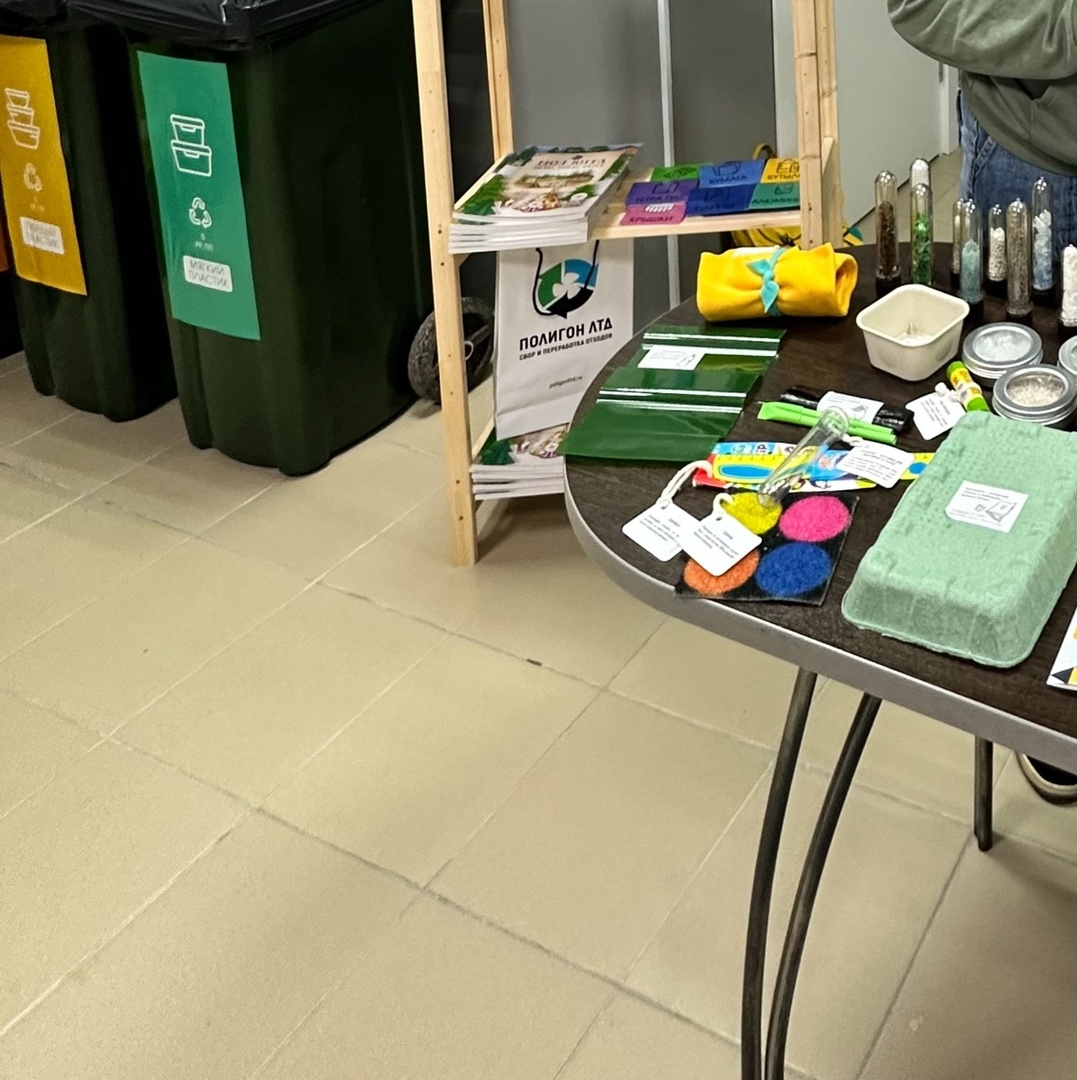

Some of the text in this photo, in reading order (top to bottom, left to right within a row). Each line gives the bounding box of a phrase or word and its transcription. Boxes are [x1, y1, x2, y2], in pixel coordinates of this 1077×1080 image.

[188, 270, 230, 287] ПЛАСТИК
[190, 260, 225, 276] МЯГКИЙ
[520, 317, 613, 351] ПОЛИГОН ЛТД
[519, 351, 536, 360] СБОР
[543, 341, 584, 355] ПЕРЕРАБОТКА
[586, 333, 613, 344] ОТХОДОВ
